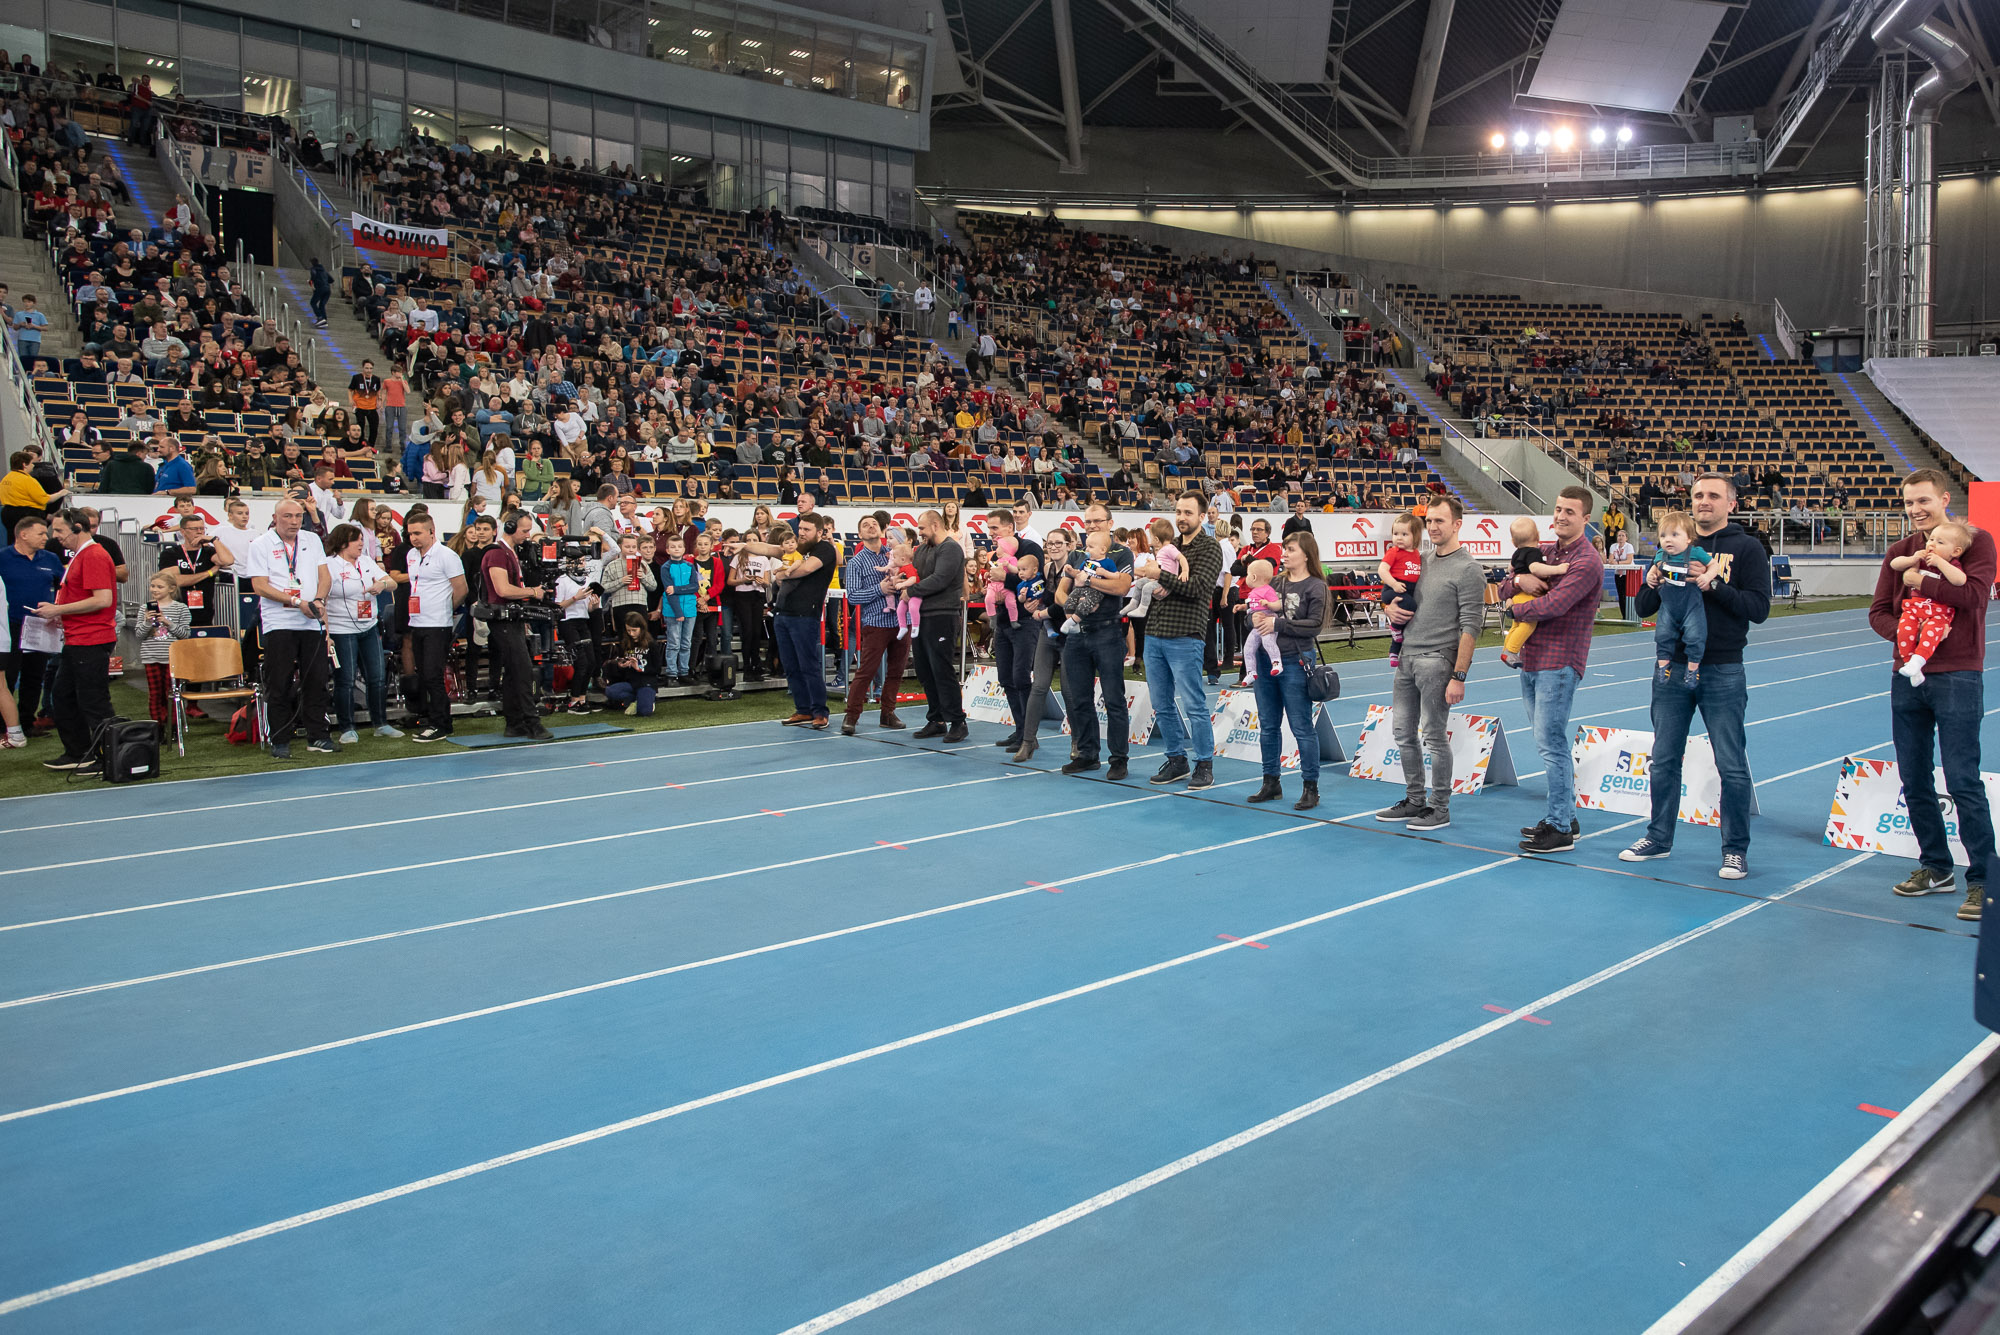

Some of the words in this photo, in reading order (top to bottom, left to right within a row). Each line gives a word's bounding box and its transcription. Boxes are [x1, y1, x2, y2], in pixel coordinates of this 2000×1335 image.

[247, 160, 263, 178] F
[858, 250, 871, 265] G
[1337, 542, 1375, 555] ORLEN
[1226, 729, 1260, 743] gener
